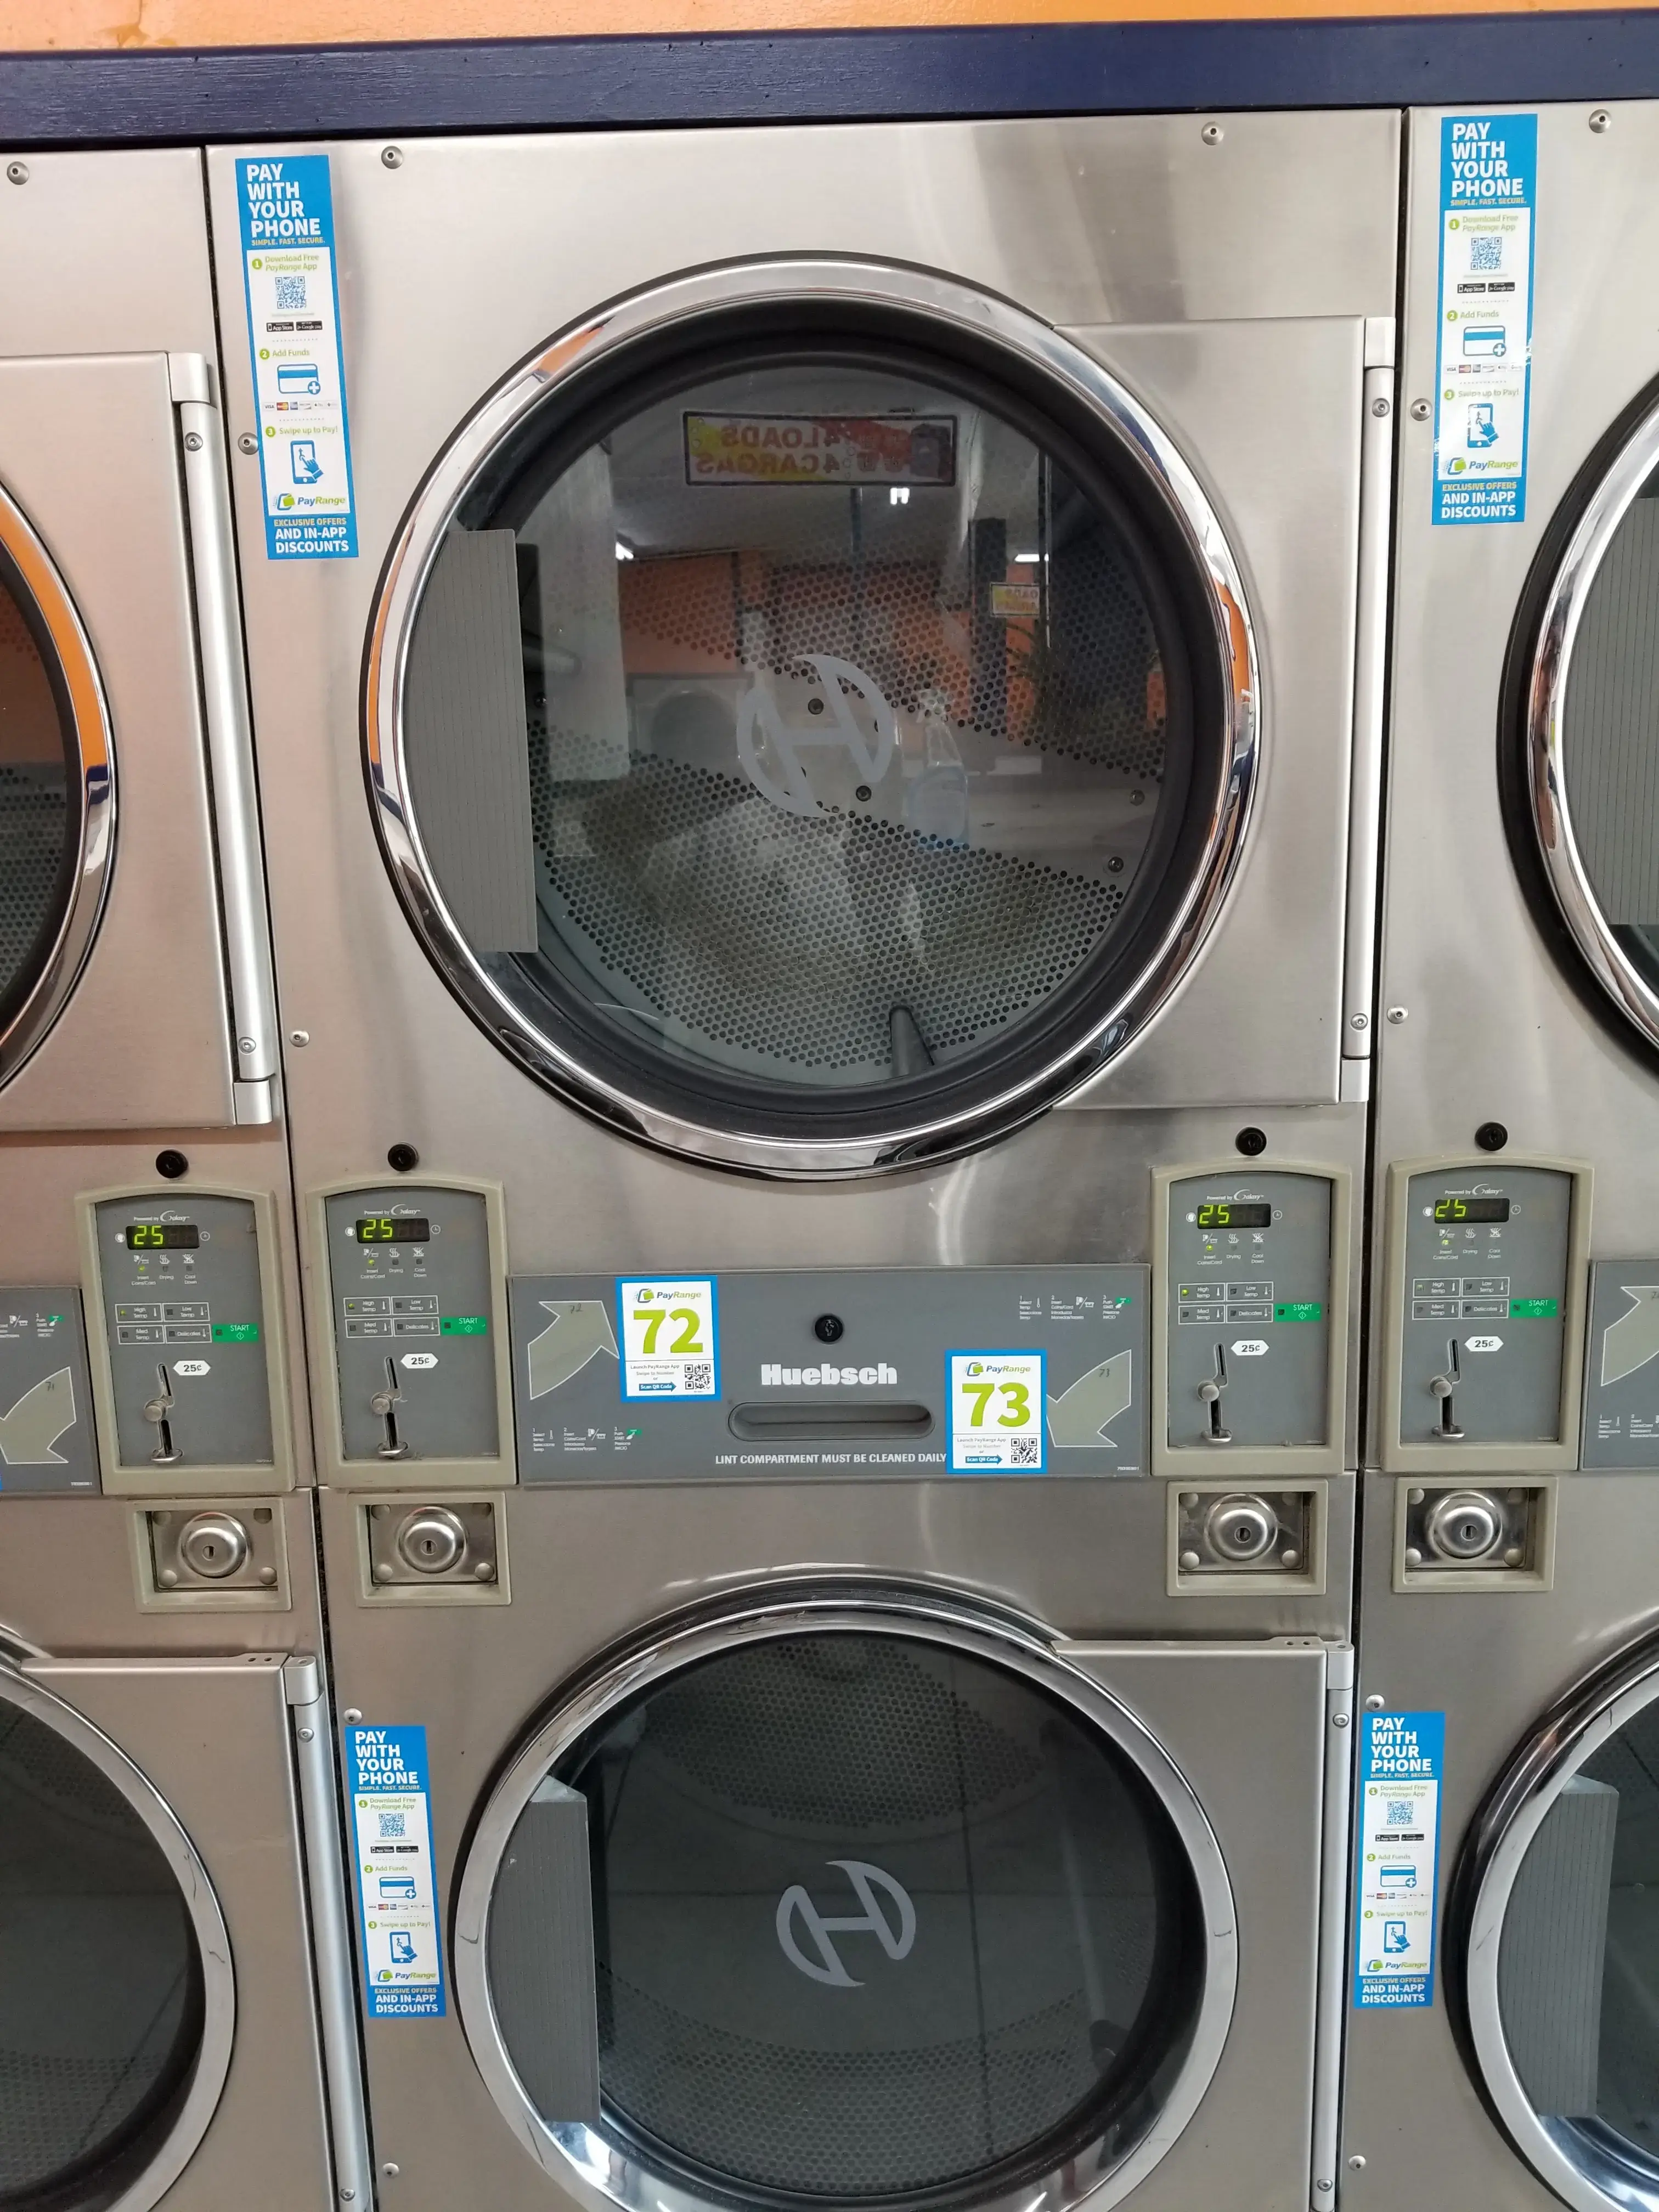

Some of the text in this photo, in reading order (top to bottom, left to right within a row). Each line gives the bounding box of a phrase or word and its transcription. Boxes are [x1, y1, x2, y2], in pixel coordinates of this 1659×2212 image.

[1453, 122, 1491, 140] PAY
[1452, 141, 1505, 159] WITH
[247, 163, 283, 181] PAY
[1452, 160, 1508, 178] YOUR
[247, 182, 299, 200] WITH
[1452, 178, 1523, 197] PHONE
[249, 201, 304, 218] YOUR
[251, 218, 321, 237] PHONE
[1503, 389, 1519, 397] Pay!
[323, 426, 337, 435] Pay!
[1469, 461, 1518, 470] PayRange
[1443, 482, 1516, 490] EXCLUSIVE OFFERS
[298, 498, 345, 506] PayRange
[1442, 492, 1516, 504] AND IN-APP
[1441, 505, 1516, 518] DISCOUNTS
[275, 527, 347, 539] AND IN-APP
[276, 540, 349, 553] DISCOUNTS
[1199, 1204, 1229, 1224] 25
[1436, 1199, 1466, 1217] 25
[363, 1219, 393, 1238] 25
[134, 1225, 163, 1245] 25
[570, 1304, 582, 1313] 72
[633, 1308, 703, 1353] 72
[1241, 1344, 1260, 1352] 25¢
[1474, 1340, 1494, 1348] 25¢
[411, 1357, 430, 1365] 25¢
[183, 1364, 202, 1372] 25¢
[761, 1363, 897, 1385] Huebsch
[1099, 1368, 1110, 1377] 73
[962, 1382, 1030, 1427] 73
[715, 1455, 737, 1464] LINT
[740, 1454, 819, 1464] COMPARTMENT
[822, 1454, 851, 1463] MUST
[869, 1453, 916, 1462] CLEANED
[918, 1453, 946, 1462] DAILY
[1373, 1718, 1405, 1730] PAY
[355, 1731, 386, 1743] PAY
[1372, 1731, 1417, 1745] WITH
[356, 1745, 400, 1757] WITH
[1371, 1746, 1419, 1758] YOUR
[357, 1758, 404, 1771] YOUR
[1372, 1759, 1431, 1771] PHONE
[358, 1771, 418, 1785] PHONE
[376, 1995, 398, 2003] AND
[1362, 1994, 1425, 2003] DISCOUNTS
[376, 2004, 438, 2013] DISCOUNTS
